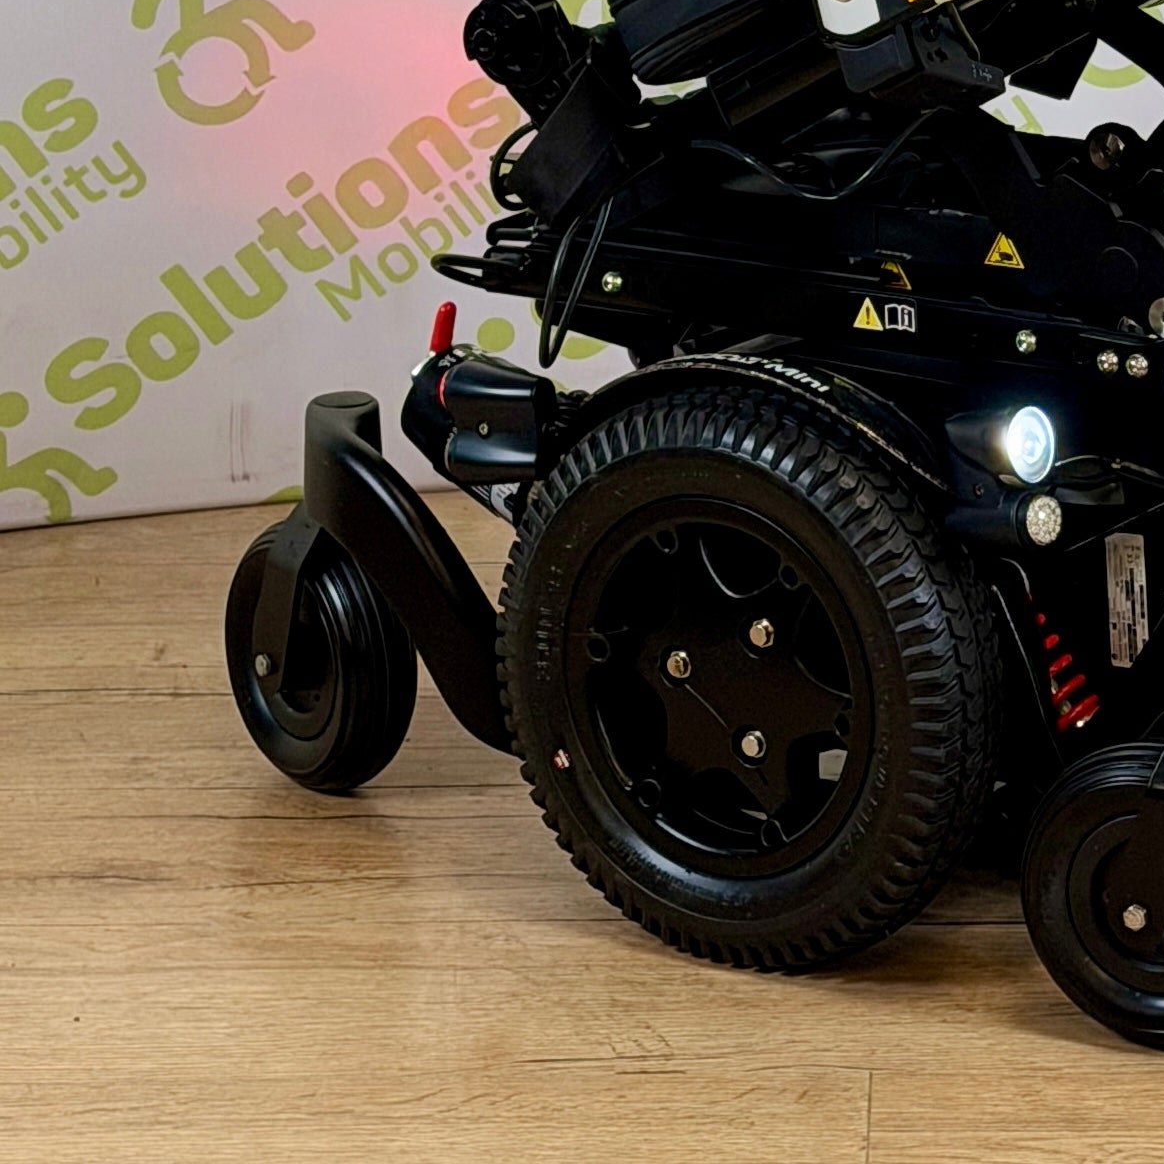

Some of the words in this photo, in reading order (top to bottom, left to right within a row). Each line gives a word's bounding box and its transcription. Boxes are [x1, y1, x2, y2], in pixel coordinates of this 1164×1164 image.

[0, 141, 147, 270] bility
[43, 78, 521, 433] Solutions
[314, 182, 503, 322] Mobili
